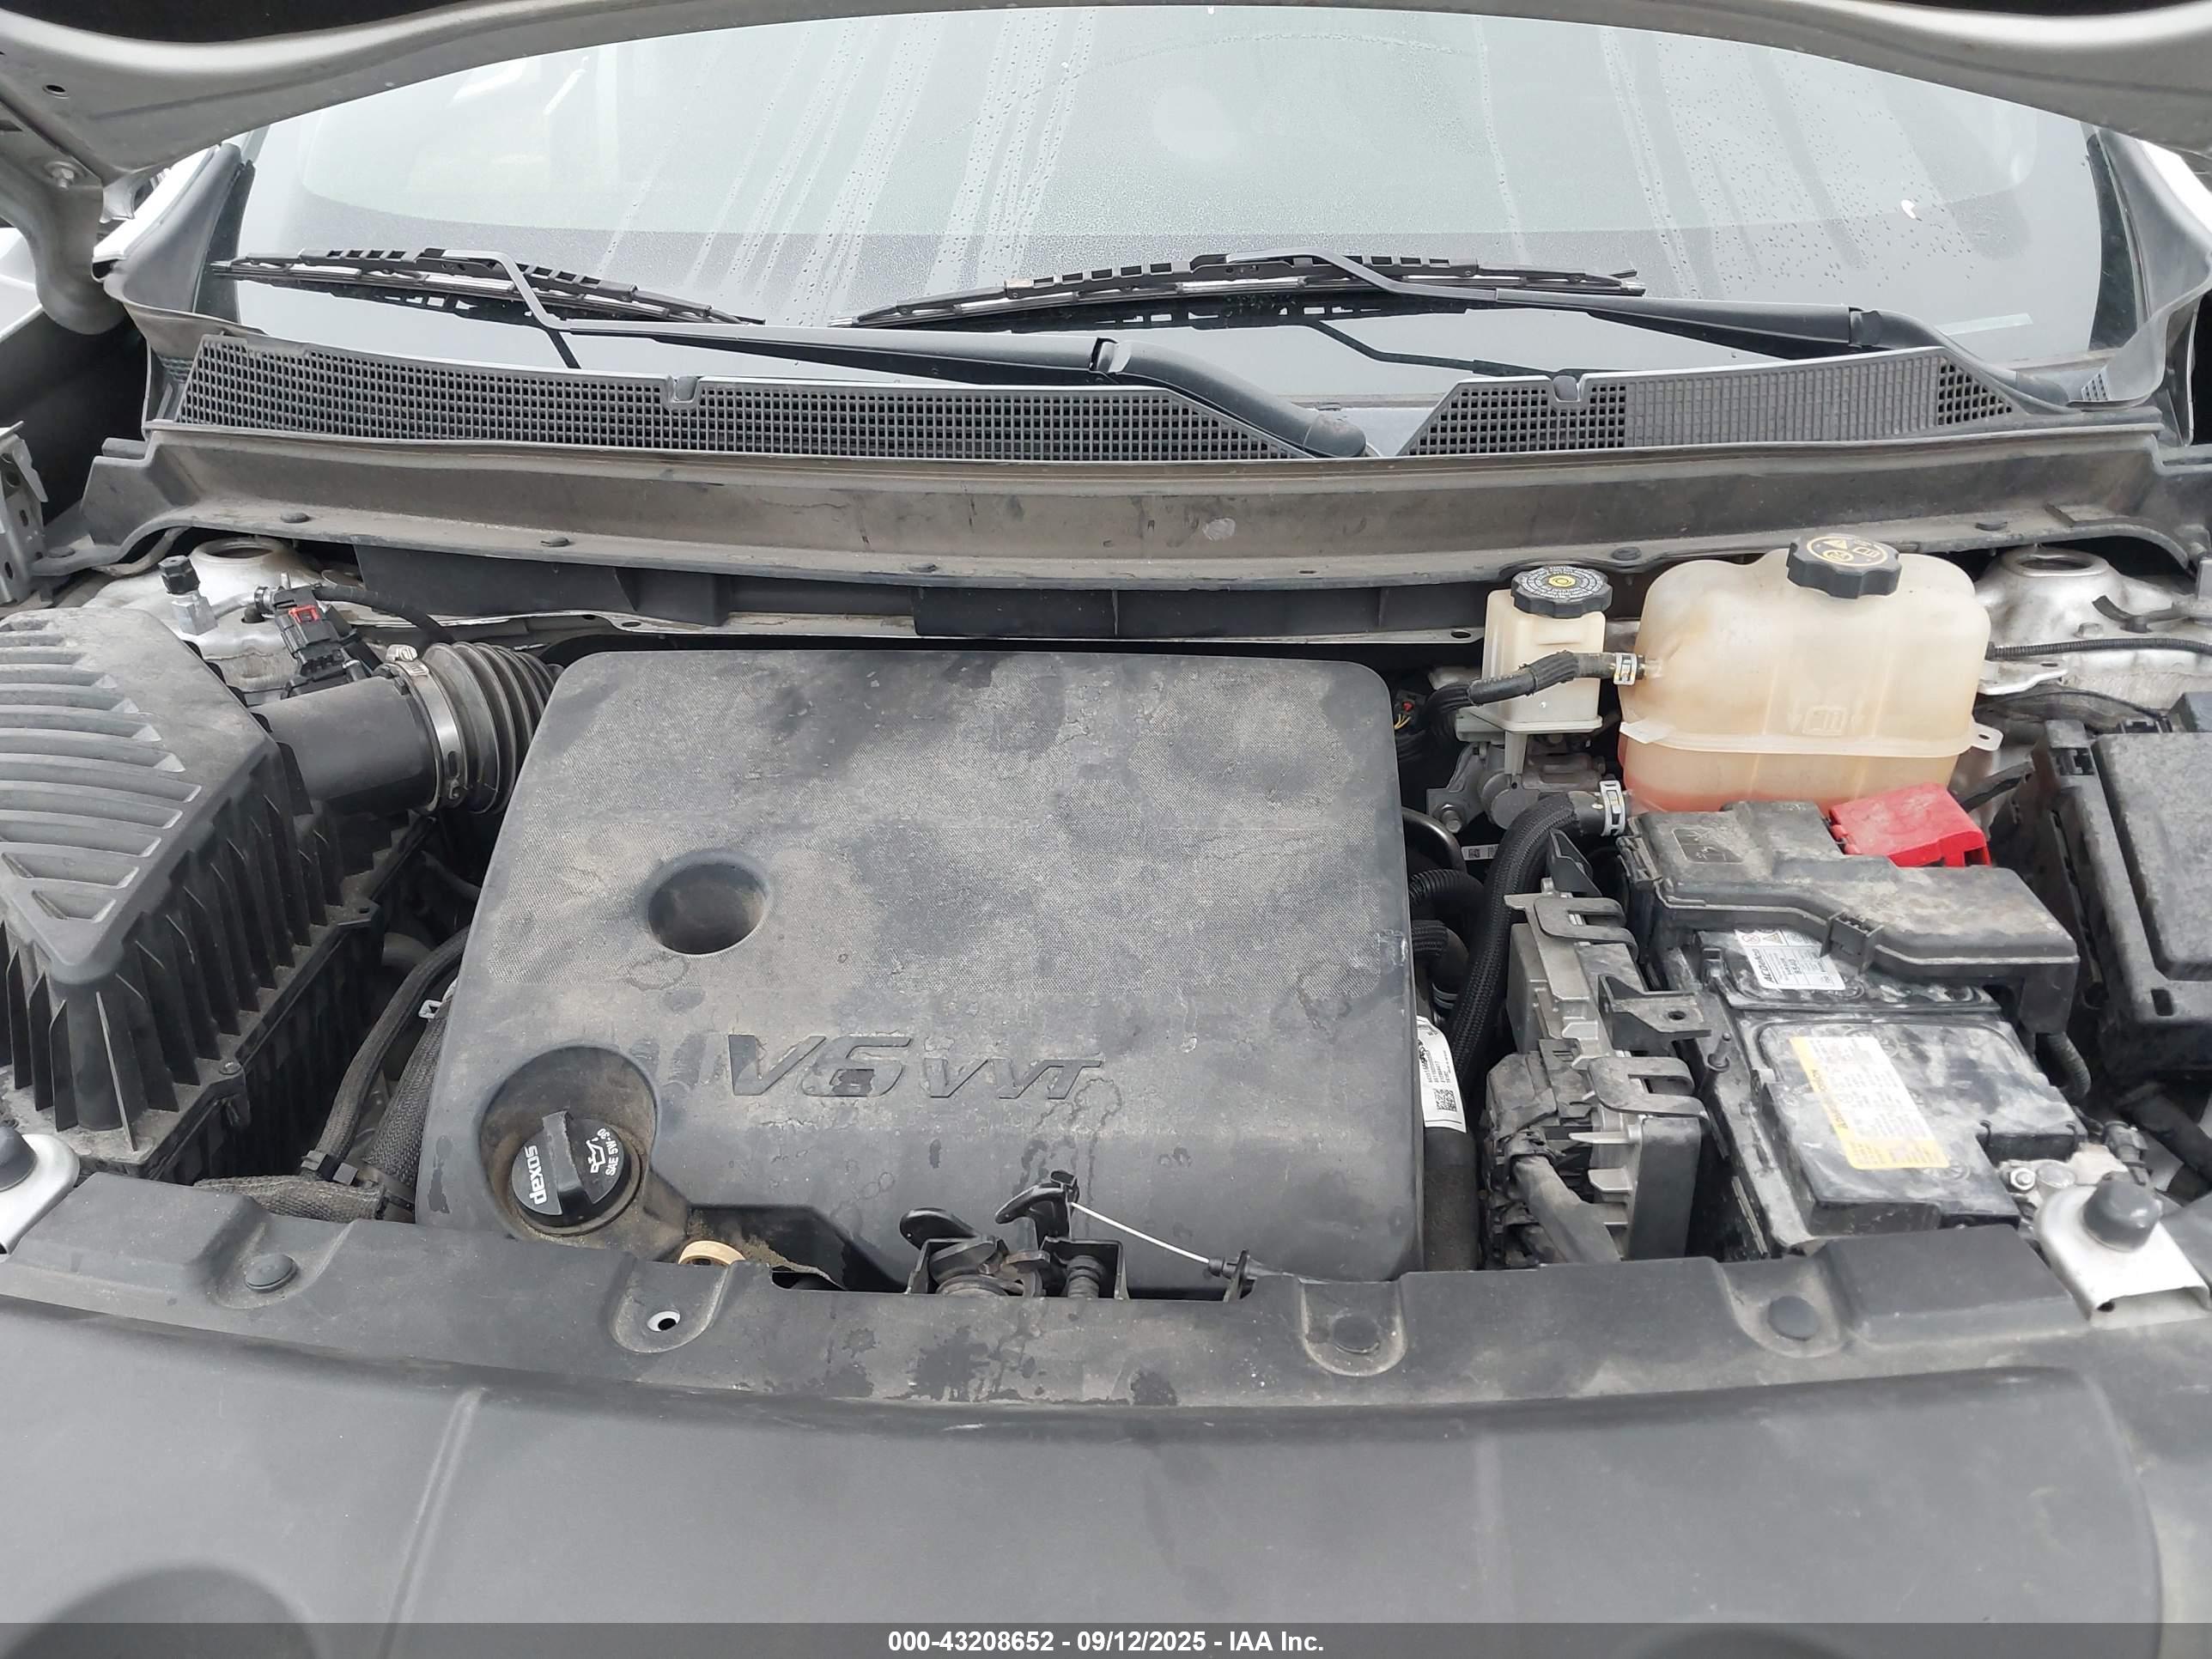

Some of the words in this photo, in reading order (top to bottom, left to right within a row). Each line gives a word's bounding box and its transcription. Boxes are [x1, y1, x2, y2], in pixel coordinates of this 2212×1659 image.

[1752, 948, 1775, 983] ACDelco
[728, 1034, 913, 1098] V6
[924, 1057, 1103, 1100] VVT
[597, 1127, 618, 1156] 5W-30
[524, 1146, 547, 1205] dexos
[605, 1157, 618, 1176] SAE
